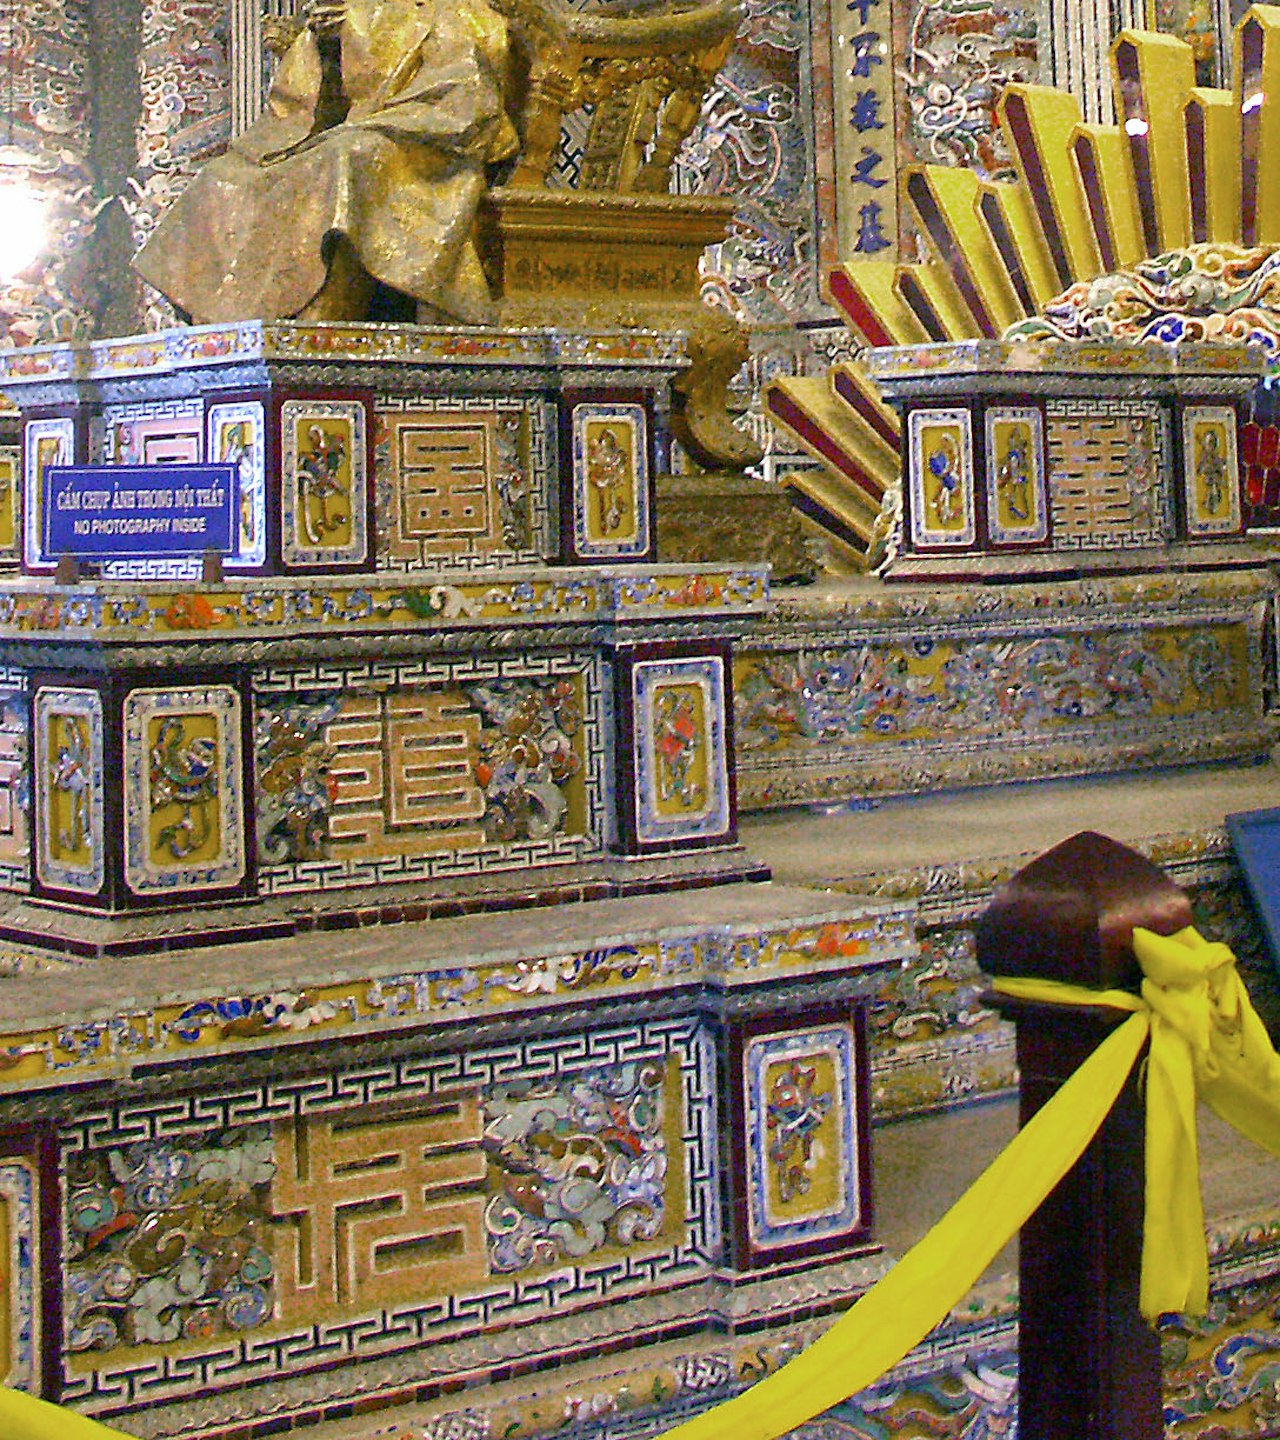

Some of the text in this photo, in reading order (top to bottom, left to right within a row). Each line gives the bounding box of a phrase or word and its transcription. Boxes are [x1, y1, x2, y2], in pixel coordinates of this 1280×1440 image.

[74, 517, 207, 535] NO PHOTOGRAPHY INSIDE
